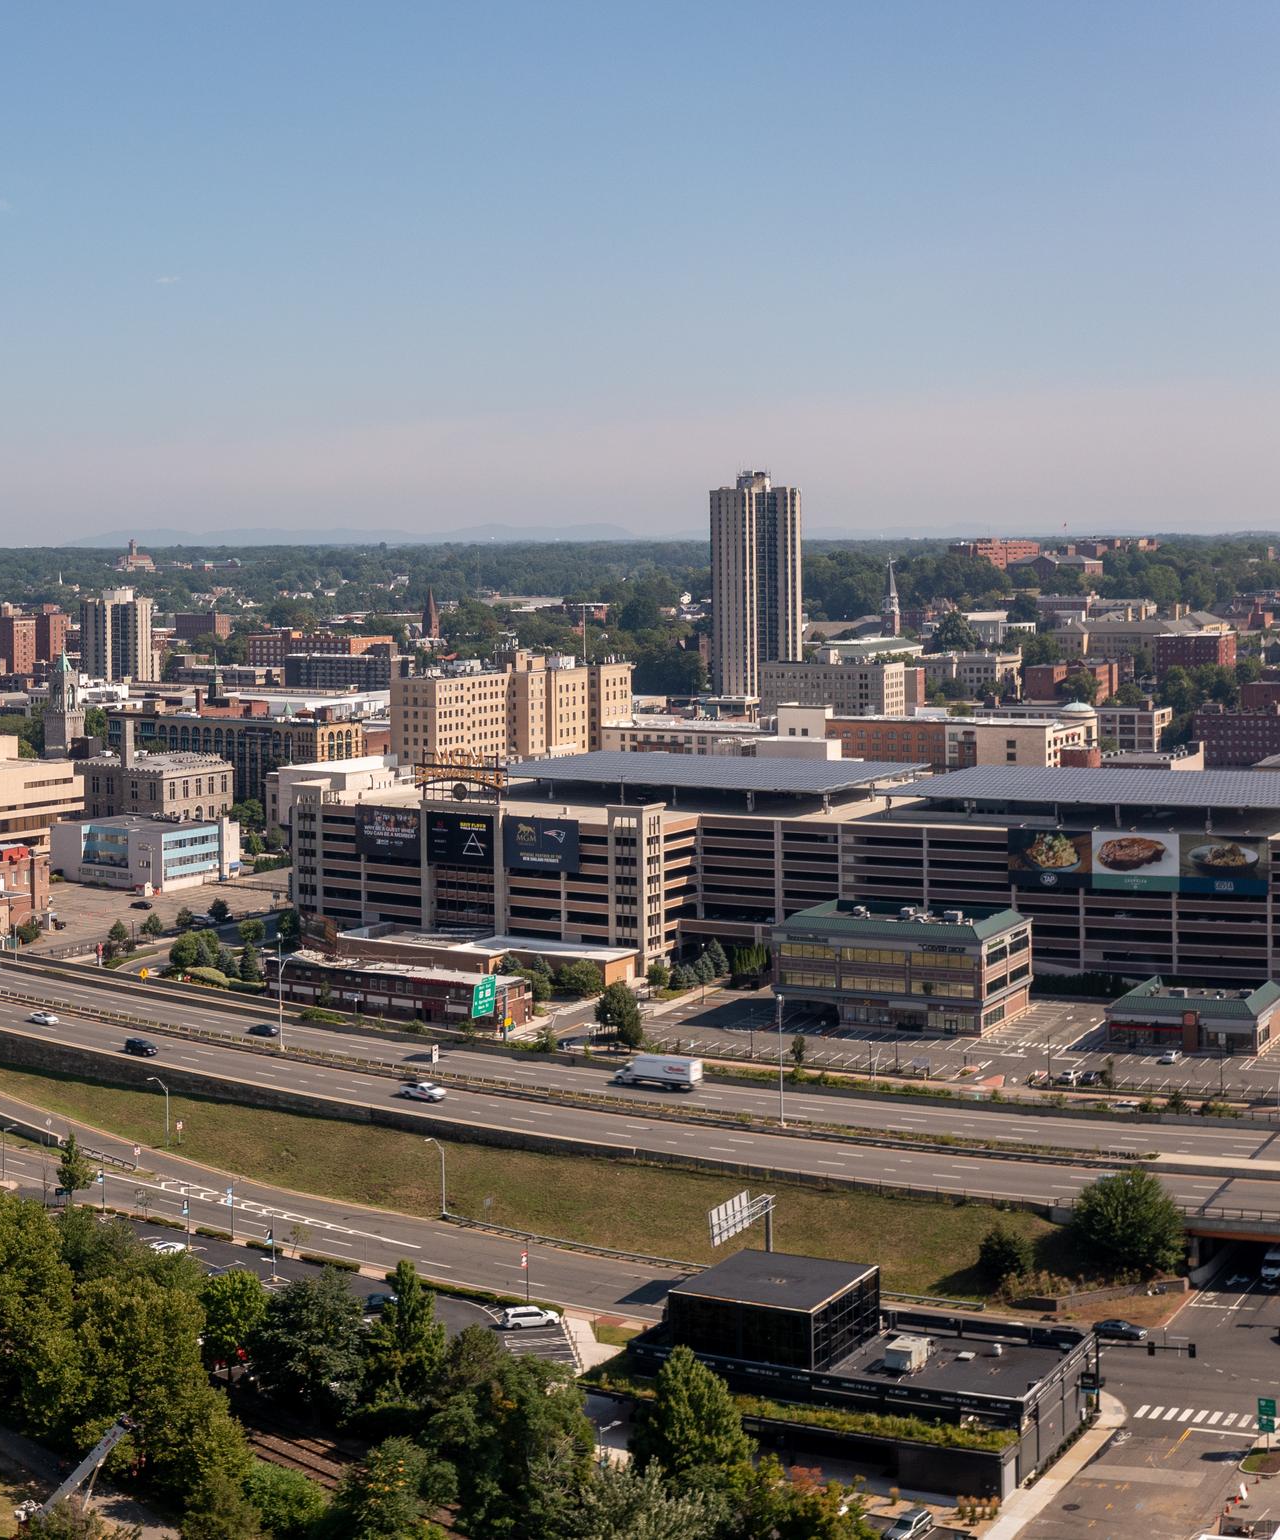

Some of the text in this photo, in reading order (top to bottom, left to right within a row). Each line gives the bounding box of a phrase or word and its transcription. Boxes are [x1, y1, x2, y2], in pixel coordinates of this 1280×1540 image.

[435, 745, 485, 767] MGM
[416, 767, 504, 788] SPRINGFIELD
[516, 834, 536, 842] MGM
